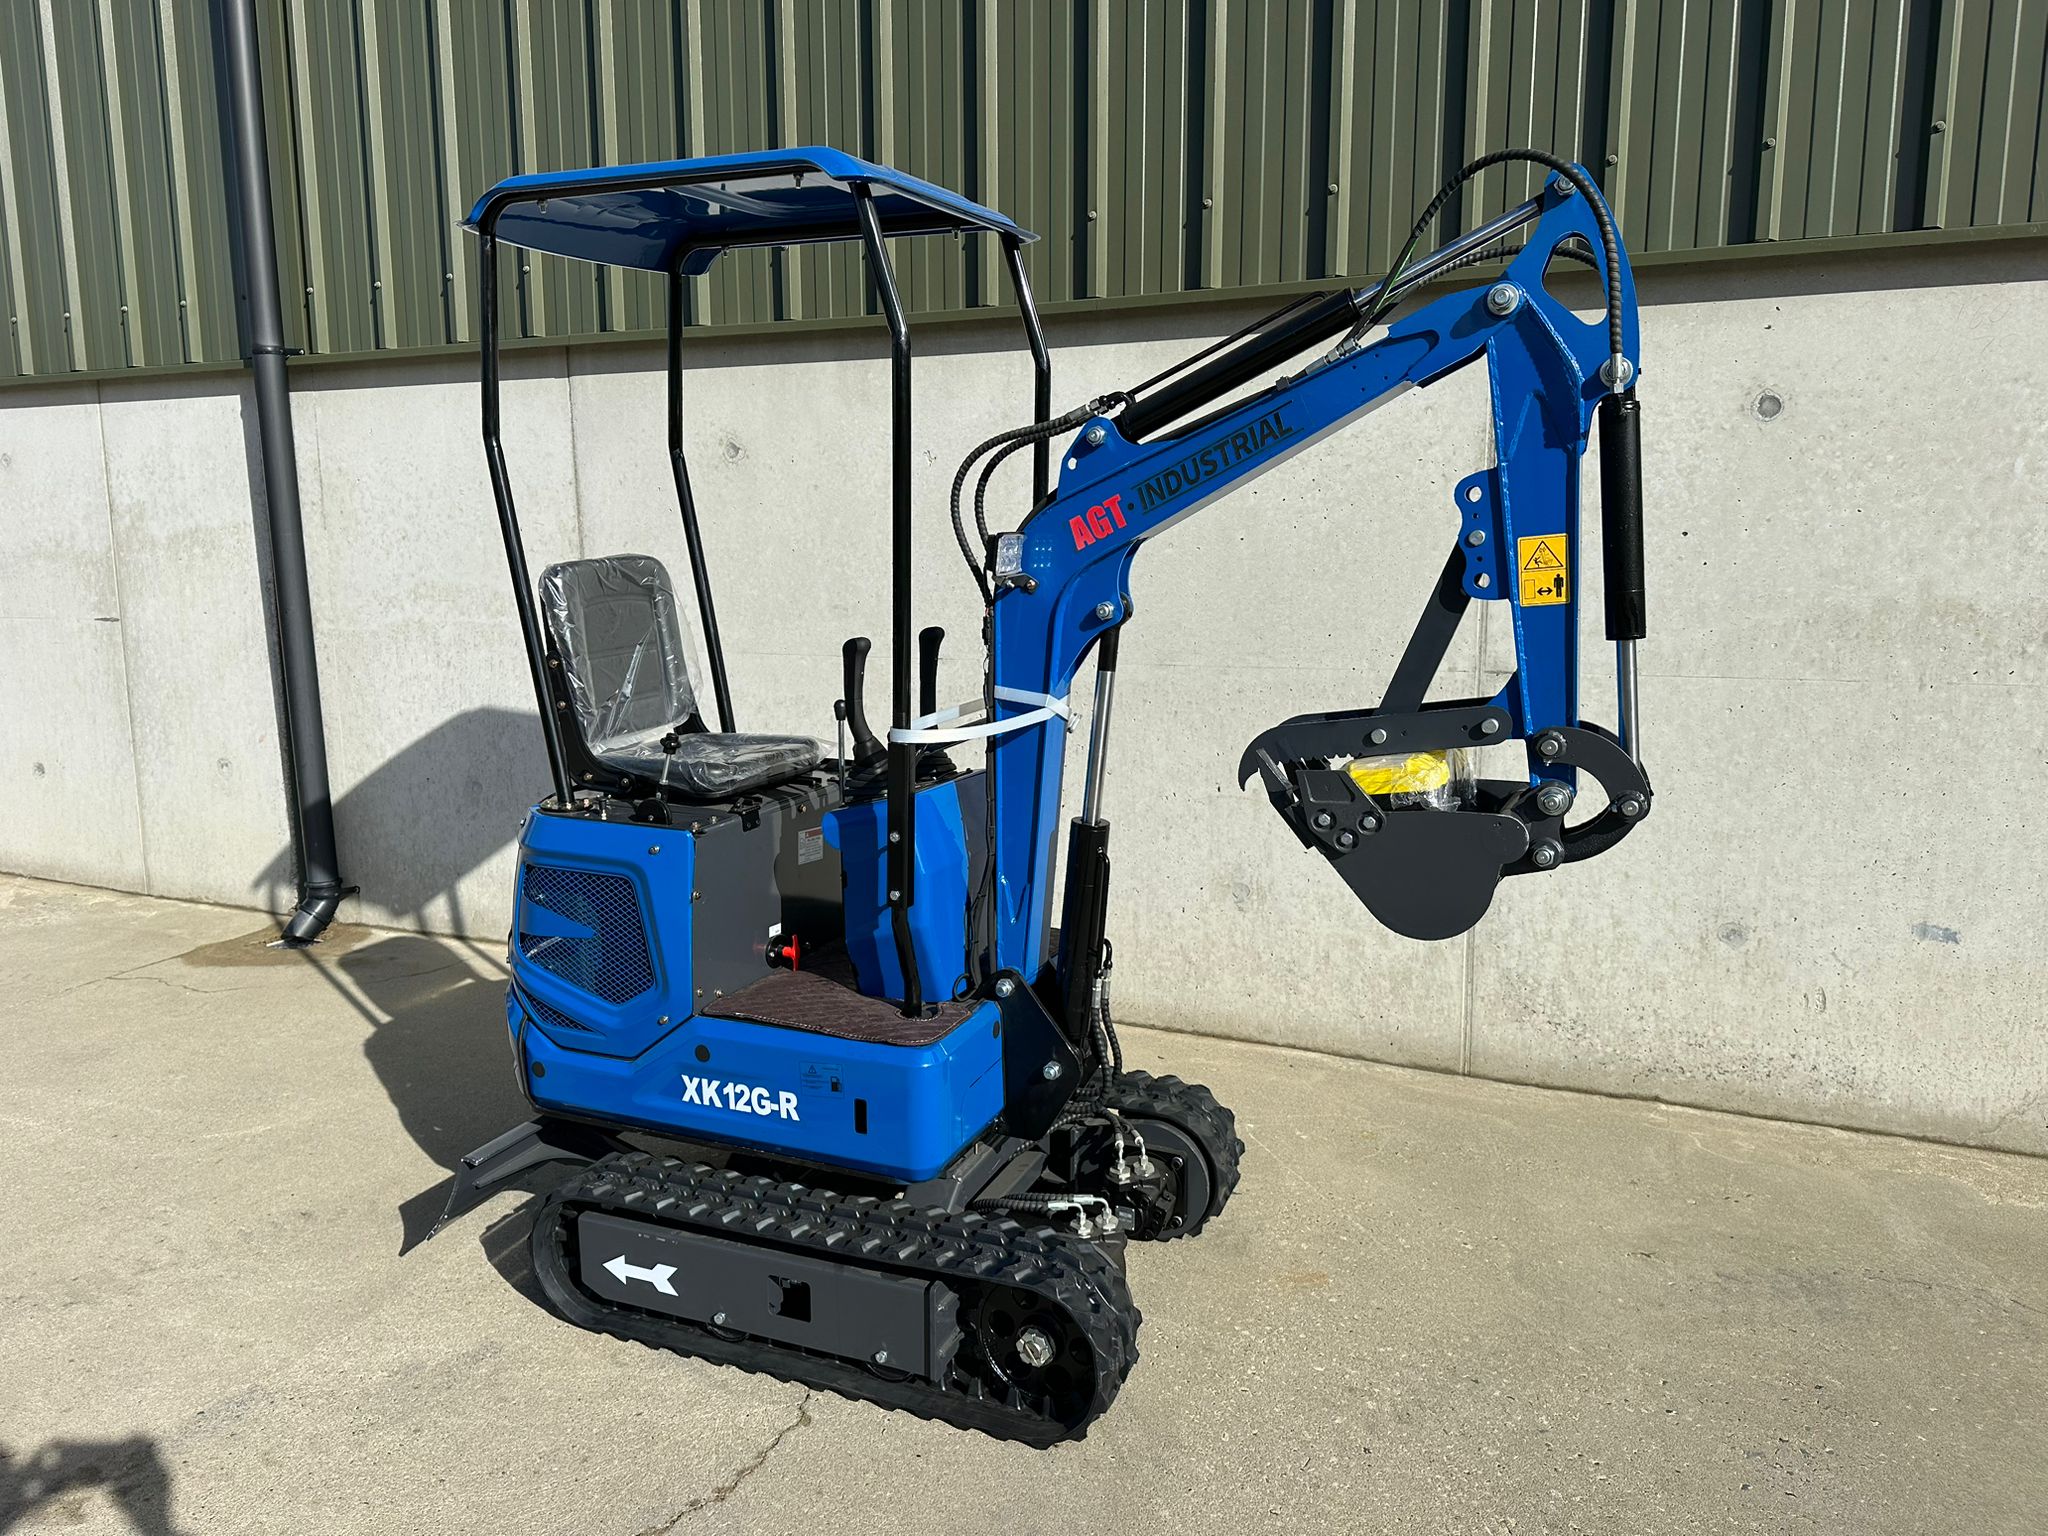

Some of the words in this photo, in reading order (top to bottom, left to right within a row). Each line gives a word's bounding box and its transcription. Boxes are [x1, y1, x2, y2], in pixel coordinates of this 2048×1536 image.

[1069, 494, 1128, 551] AGT
[1137, 411, 1294, 511] INDUSTRIAL
[681, 1074, 800, 1121] XK12G-R
